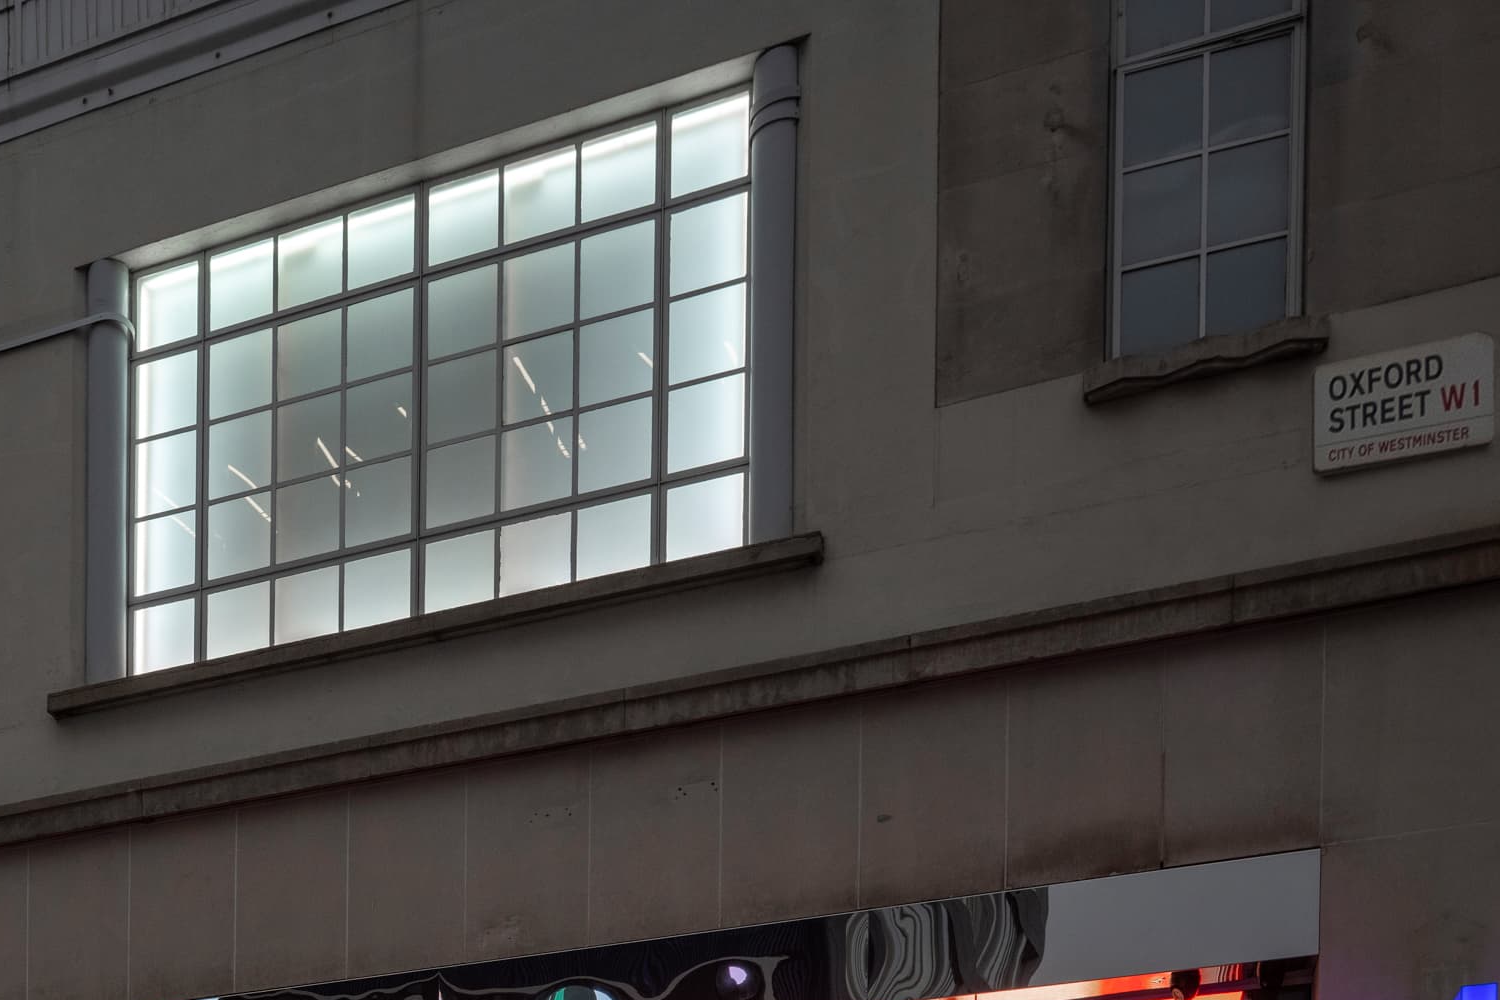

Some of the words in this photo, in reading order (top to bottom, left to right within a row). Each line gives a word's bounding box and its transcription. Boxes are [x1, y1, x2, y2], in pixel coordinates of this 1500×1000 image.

[1328, 354, 1443, 401] OXFORD
[1328, 389, 1431, 433] STREET
[1328, 447, 1355, 462] CITY
[1358, 443, 1375, 457] OF
[1378, 427, 1470, 454] WESTMINSTER
